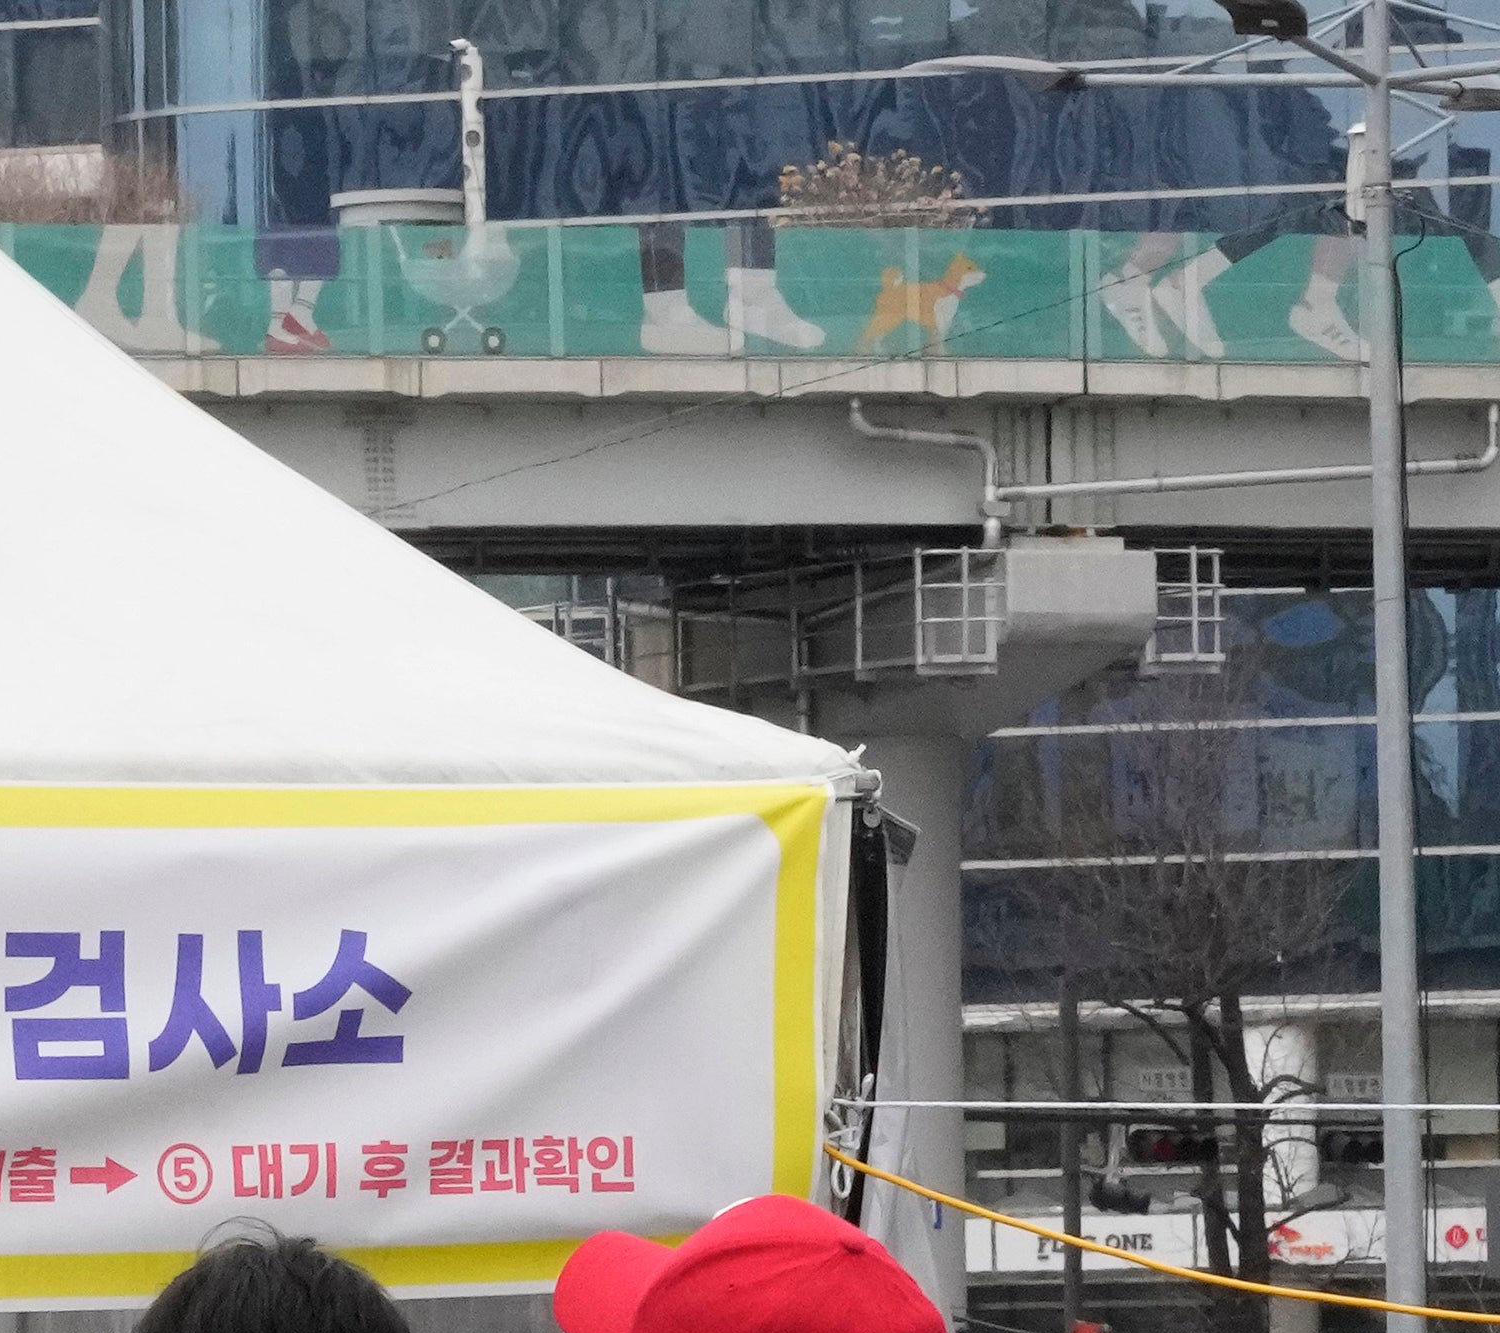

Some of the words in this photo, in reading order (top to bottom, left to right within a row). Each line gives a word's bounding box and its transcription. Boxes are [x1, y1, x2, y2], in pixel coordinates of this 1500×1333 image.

[232, 1142, 339, 1199] 대기
[360, 1140, 409, 1198] 후
[429, 1135, 637, 1195] 결과확인
[1104, 1232, 1153, 1252] ONE
